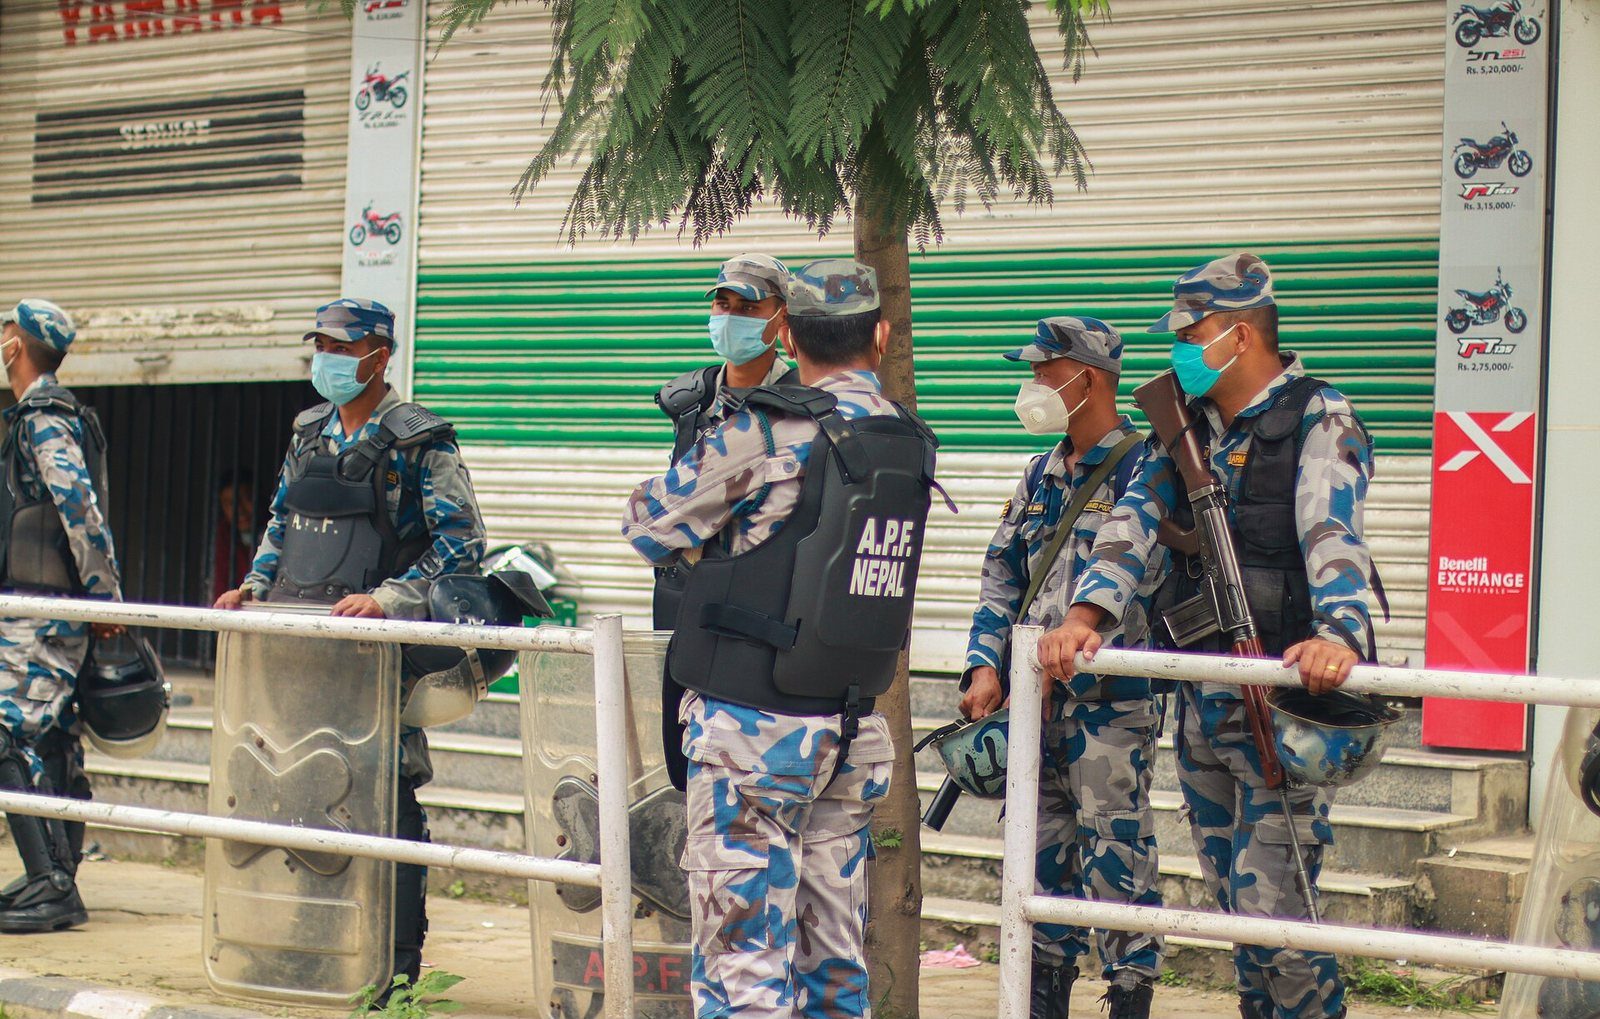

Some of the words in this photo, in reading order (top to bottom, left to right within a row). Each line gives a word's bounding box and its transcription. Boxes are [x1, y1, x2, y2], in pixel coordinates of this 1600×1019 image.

[1466, 66, 1479, 75] Rs.
[1480, 65, 1524, 75] 5,20,000/-
[1476, 202, 1517, 211] 3,15,000/-
[1457, 363, 1469, 371] Rs.
[1471, 363, 1514, 372] 2,75,000/-
[856, 518, 914, 557] A.P.F.
[1439, 556, 1487, 571] Benelli
[849, 558, 905, 597] NEPAL
[1437, 571, 1524, 588] EXCHANGE
